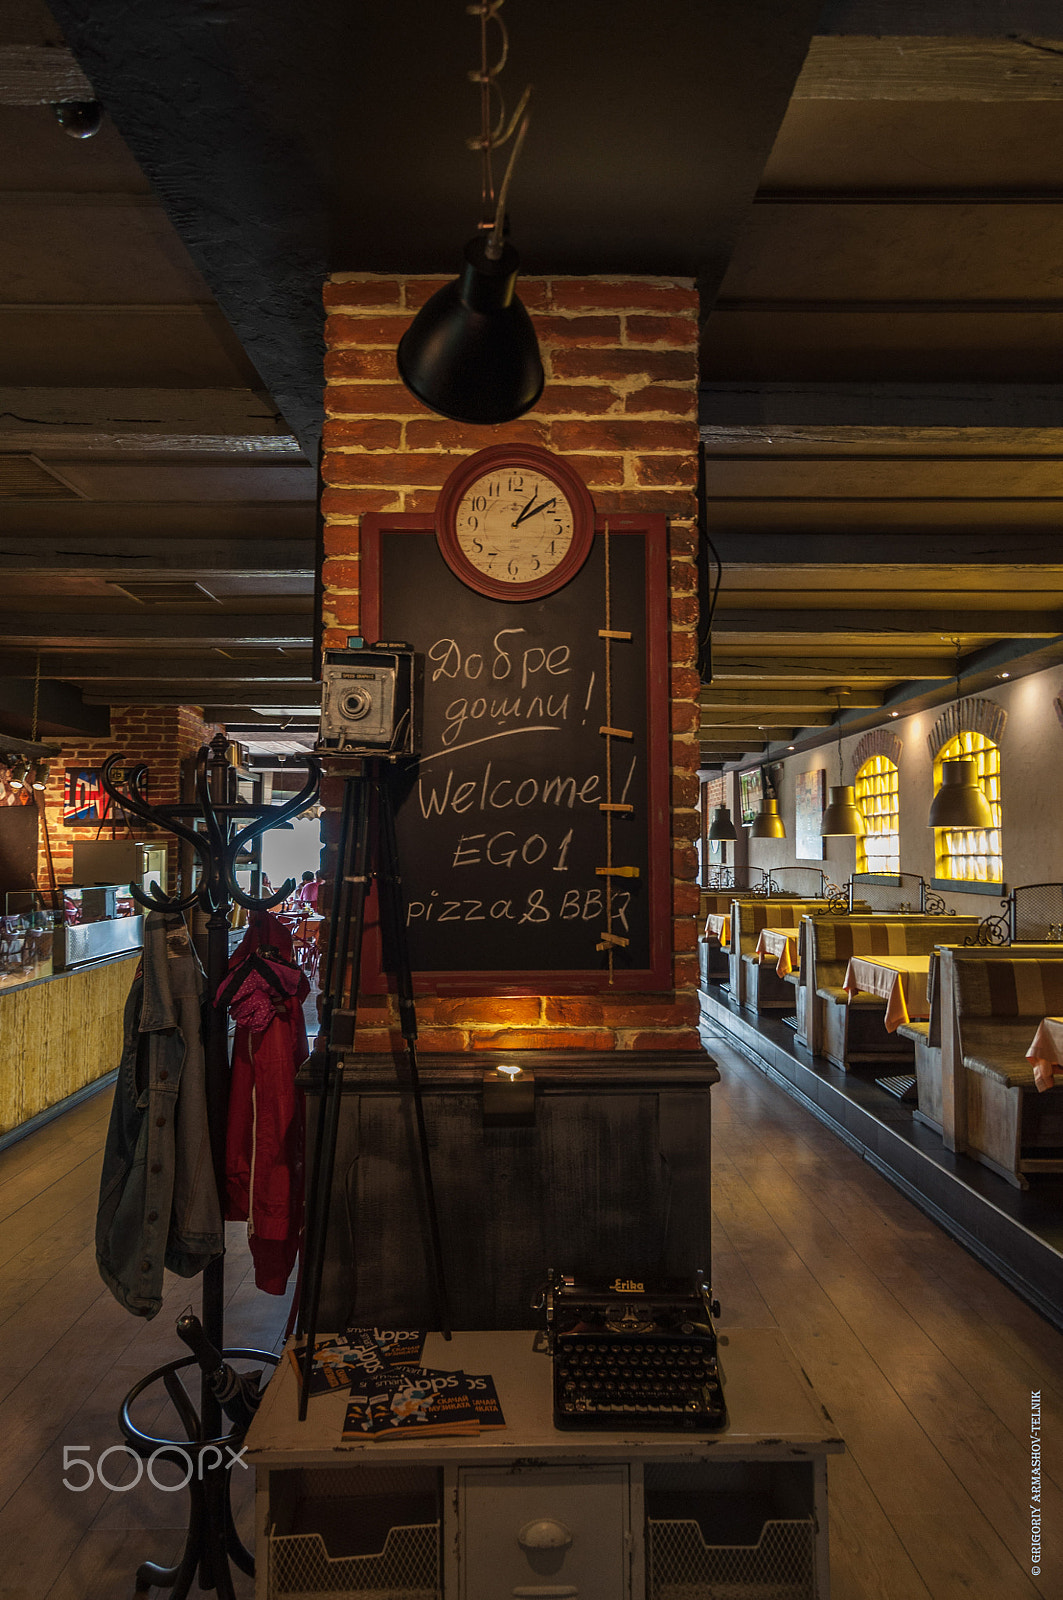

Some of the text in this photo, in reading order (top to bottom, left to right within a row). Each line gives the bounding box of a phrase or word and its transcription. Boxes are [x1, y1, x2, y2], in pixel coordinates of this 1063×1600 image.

[489, 482, 500, 497] 11
[508, 476, 524, 492] 12
[471, 495, 487, 512] 10
[467, 516, 479, 532] 9
[552, 518, 563, 535] 3
[471, 537, 484, 554] 8
[544, 540, 558, 556] 4
[488, 552, 498, 569] 7
[507, 559, 519, 576] 6
[530, 554, 541, 571] 5
[428, 627, 572, 689] Добре
[406, 889, 517, 928] pizza
[559, 888, 631, 932] BBQ
[611, 1278, 645, 1292] Erika
[398, 1374, 459, 1392] Apps
